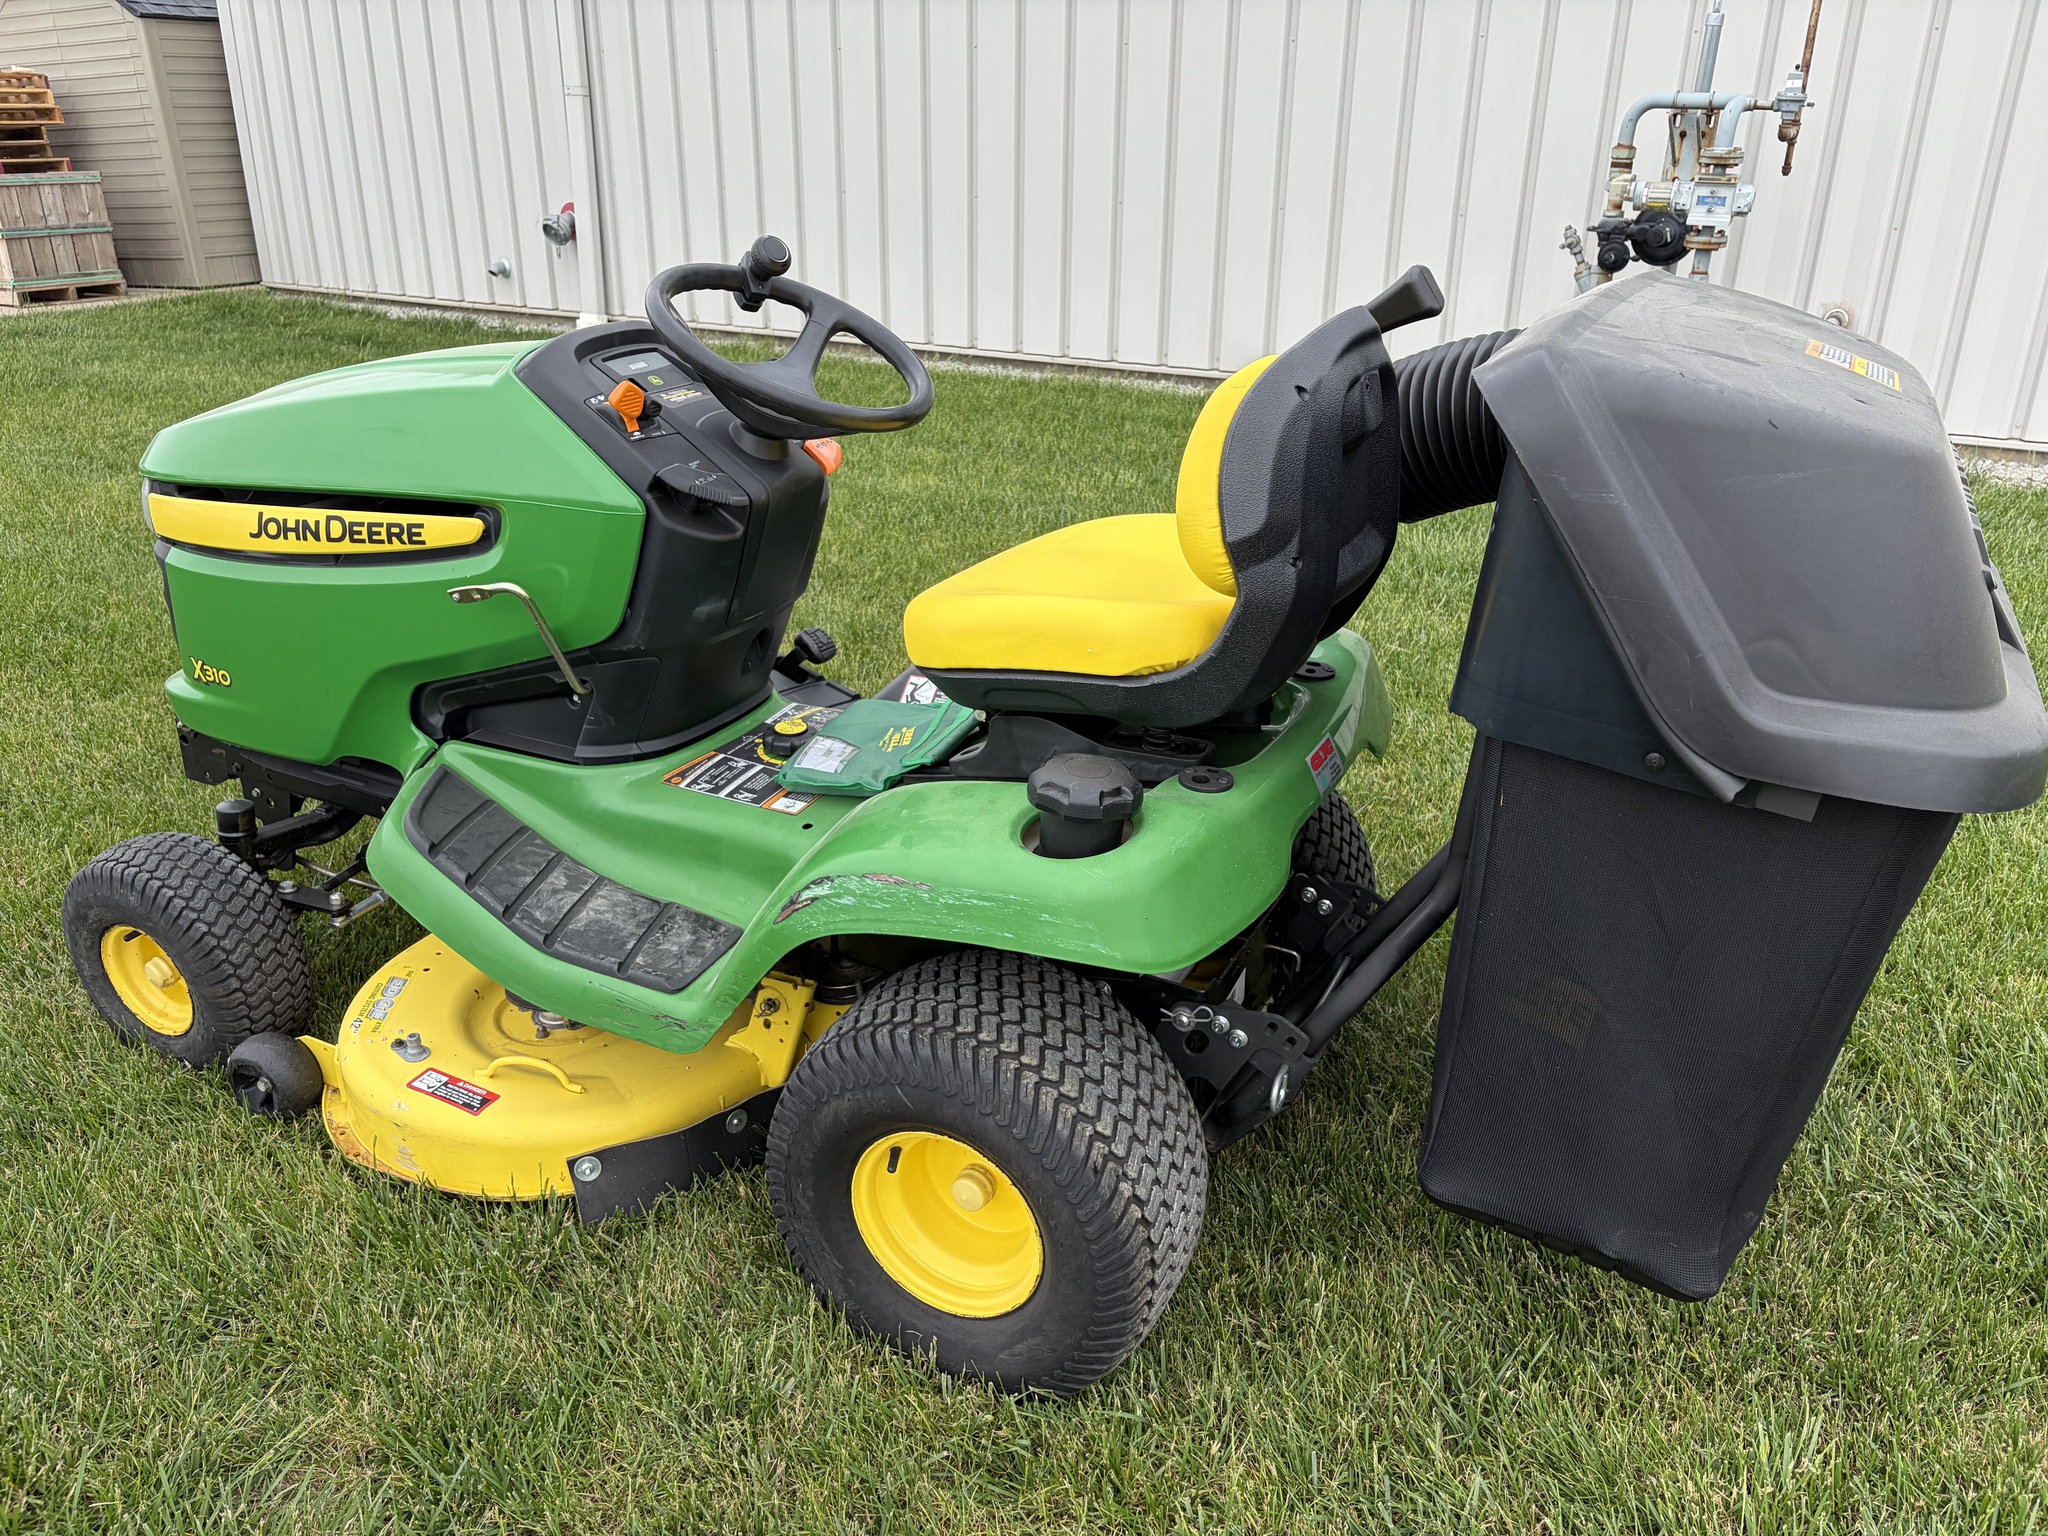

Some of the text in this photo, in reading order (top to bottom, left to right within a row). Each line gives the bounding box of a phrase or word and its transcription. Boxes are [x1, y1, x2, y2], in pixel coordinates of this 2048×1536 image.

[250, 511, 427, 545] JOHN DEERE
[189, 655, 232, 687] X310
[357, 999, 372, 1017] SYSTEM
[366, 975, 409, 1021] EDGE
[463, 1083, 488, 1096] DANGER
